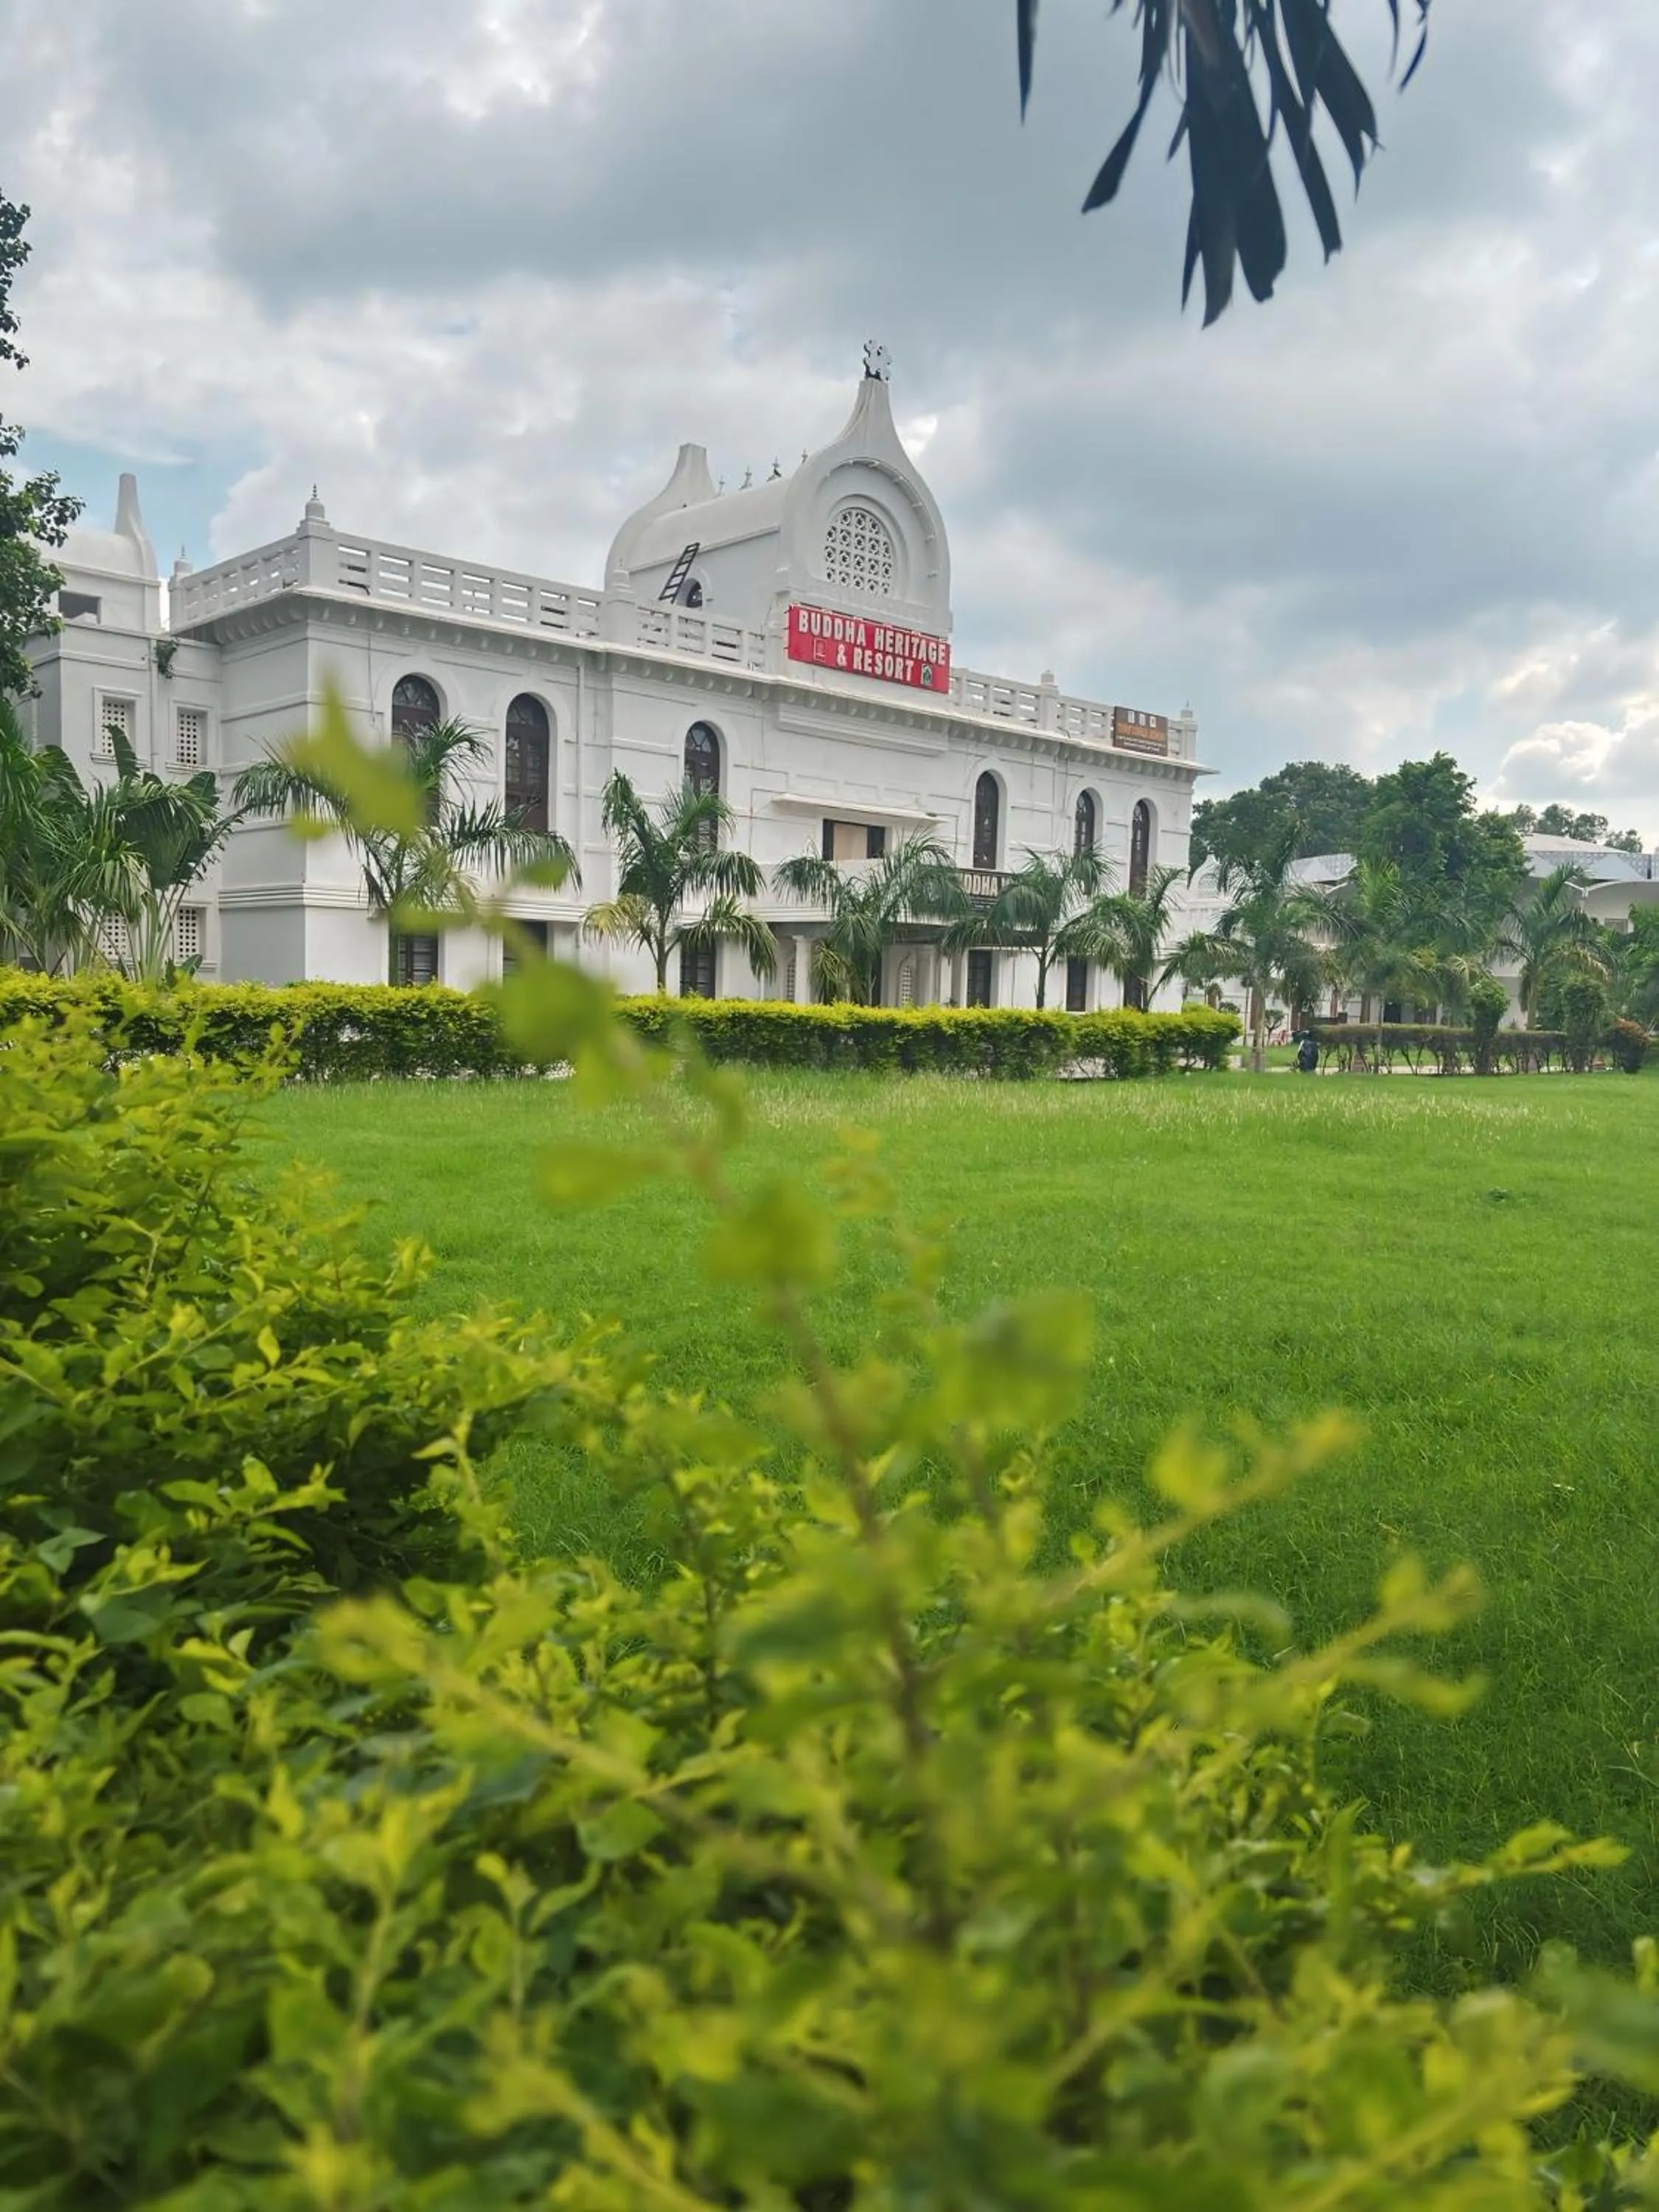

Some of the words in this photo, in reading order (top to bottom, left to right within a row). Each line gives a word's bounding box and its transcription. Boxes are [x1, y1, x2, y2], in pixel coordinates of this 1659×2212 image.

[799, 610, 866, 647] BUDDHA
[874, 627, 945, 664] HERITAGE
[836, 644, 847, 667] &
[853, 647, 915, 682] RESORT
